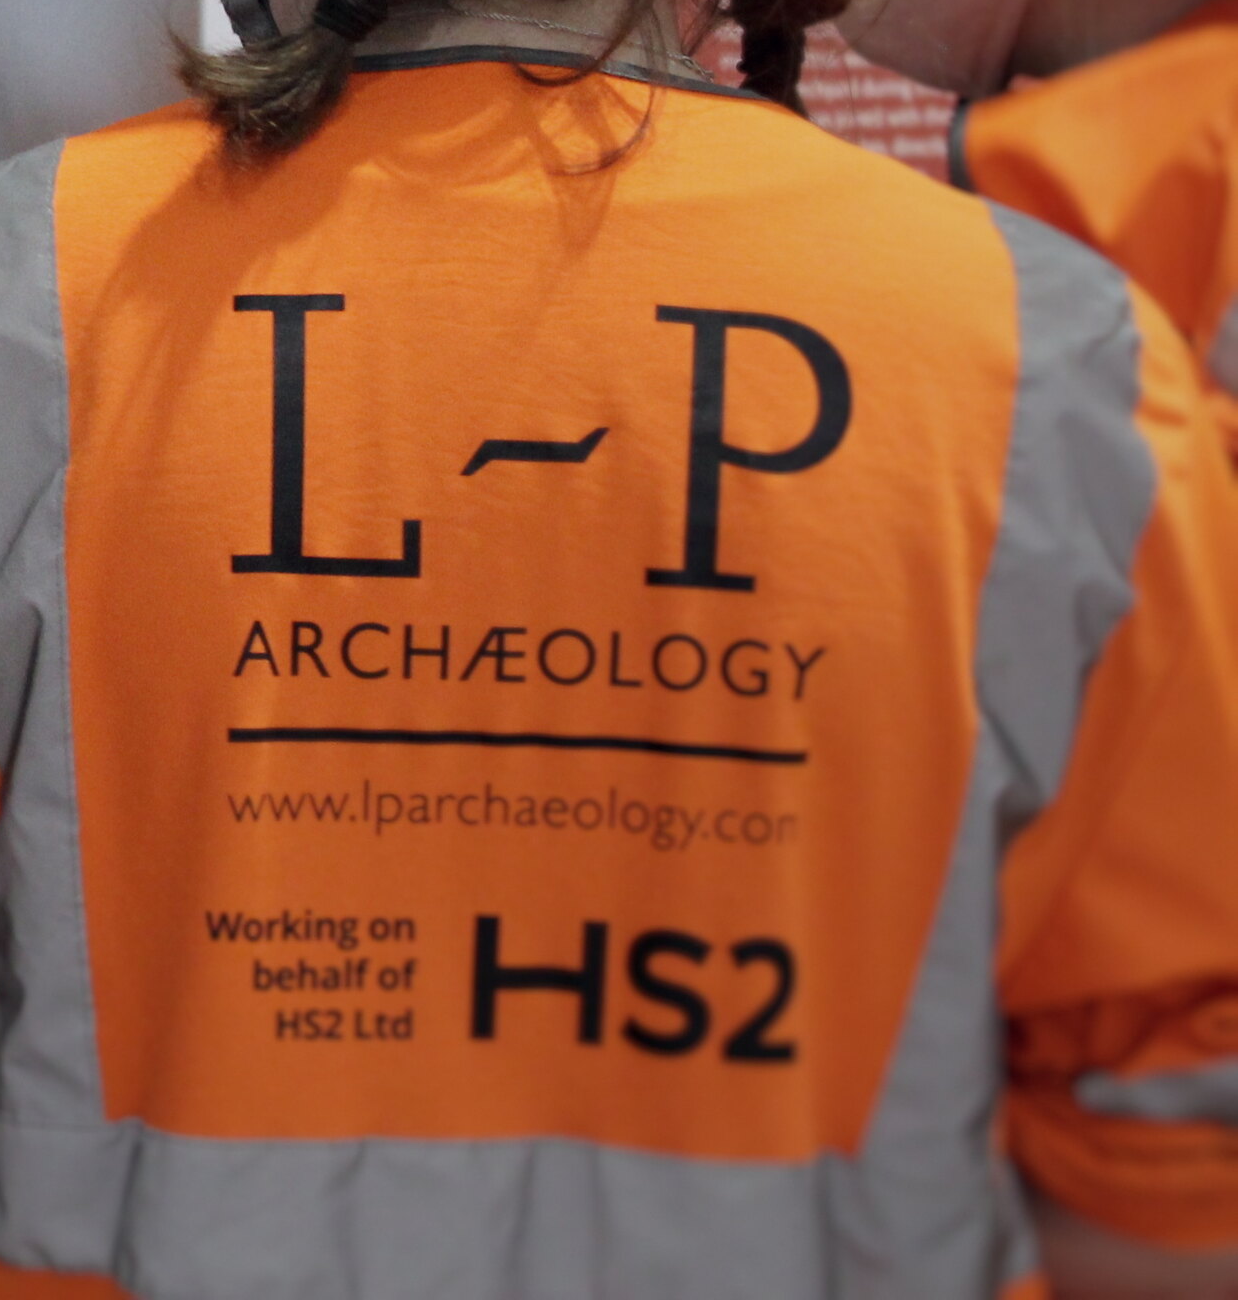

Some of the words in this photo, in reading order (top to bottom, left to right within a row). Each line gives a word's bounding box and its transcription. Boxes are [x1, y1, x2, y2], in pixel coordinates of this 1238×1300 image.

[232, 620, 826, 701] ARCHÆOLOGY
[205, 910, 359, 950] Working
[368, 917, 416, 942] on
[252, 958, 368, 991] behalf
[378, 958, 416, 991] of
[470, 913, 798, 1063] HS2
[275, 1009, 344, 1040] HS2
[354, 1009, 414, 1040] Ltd
